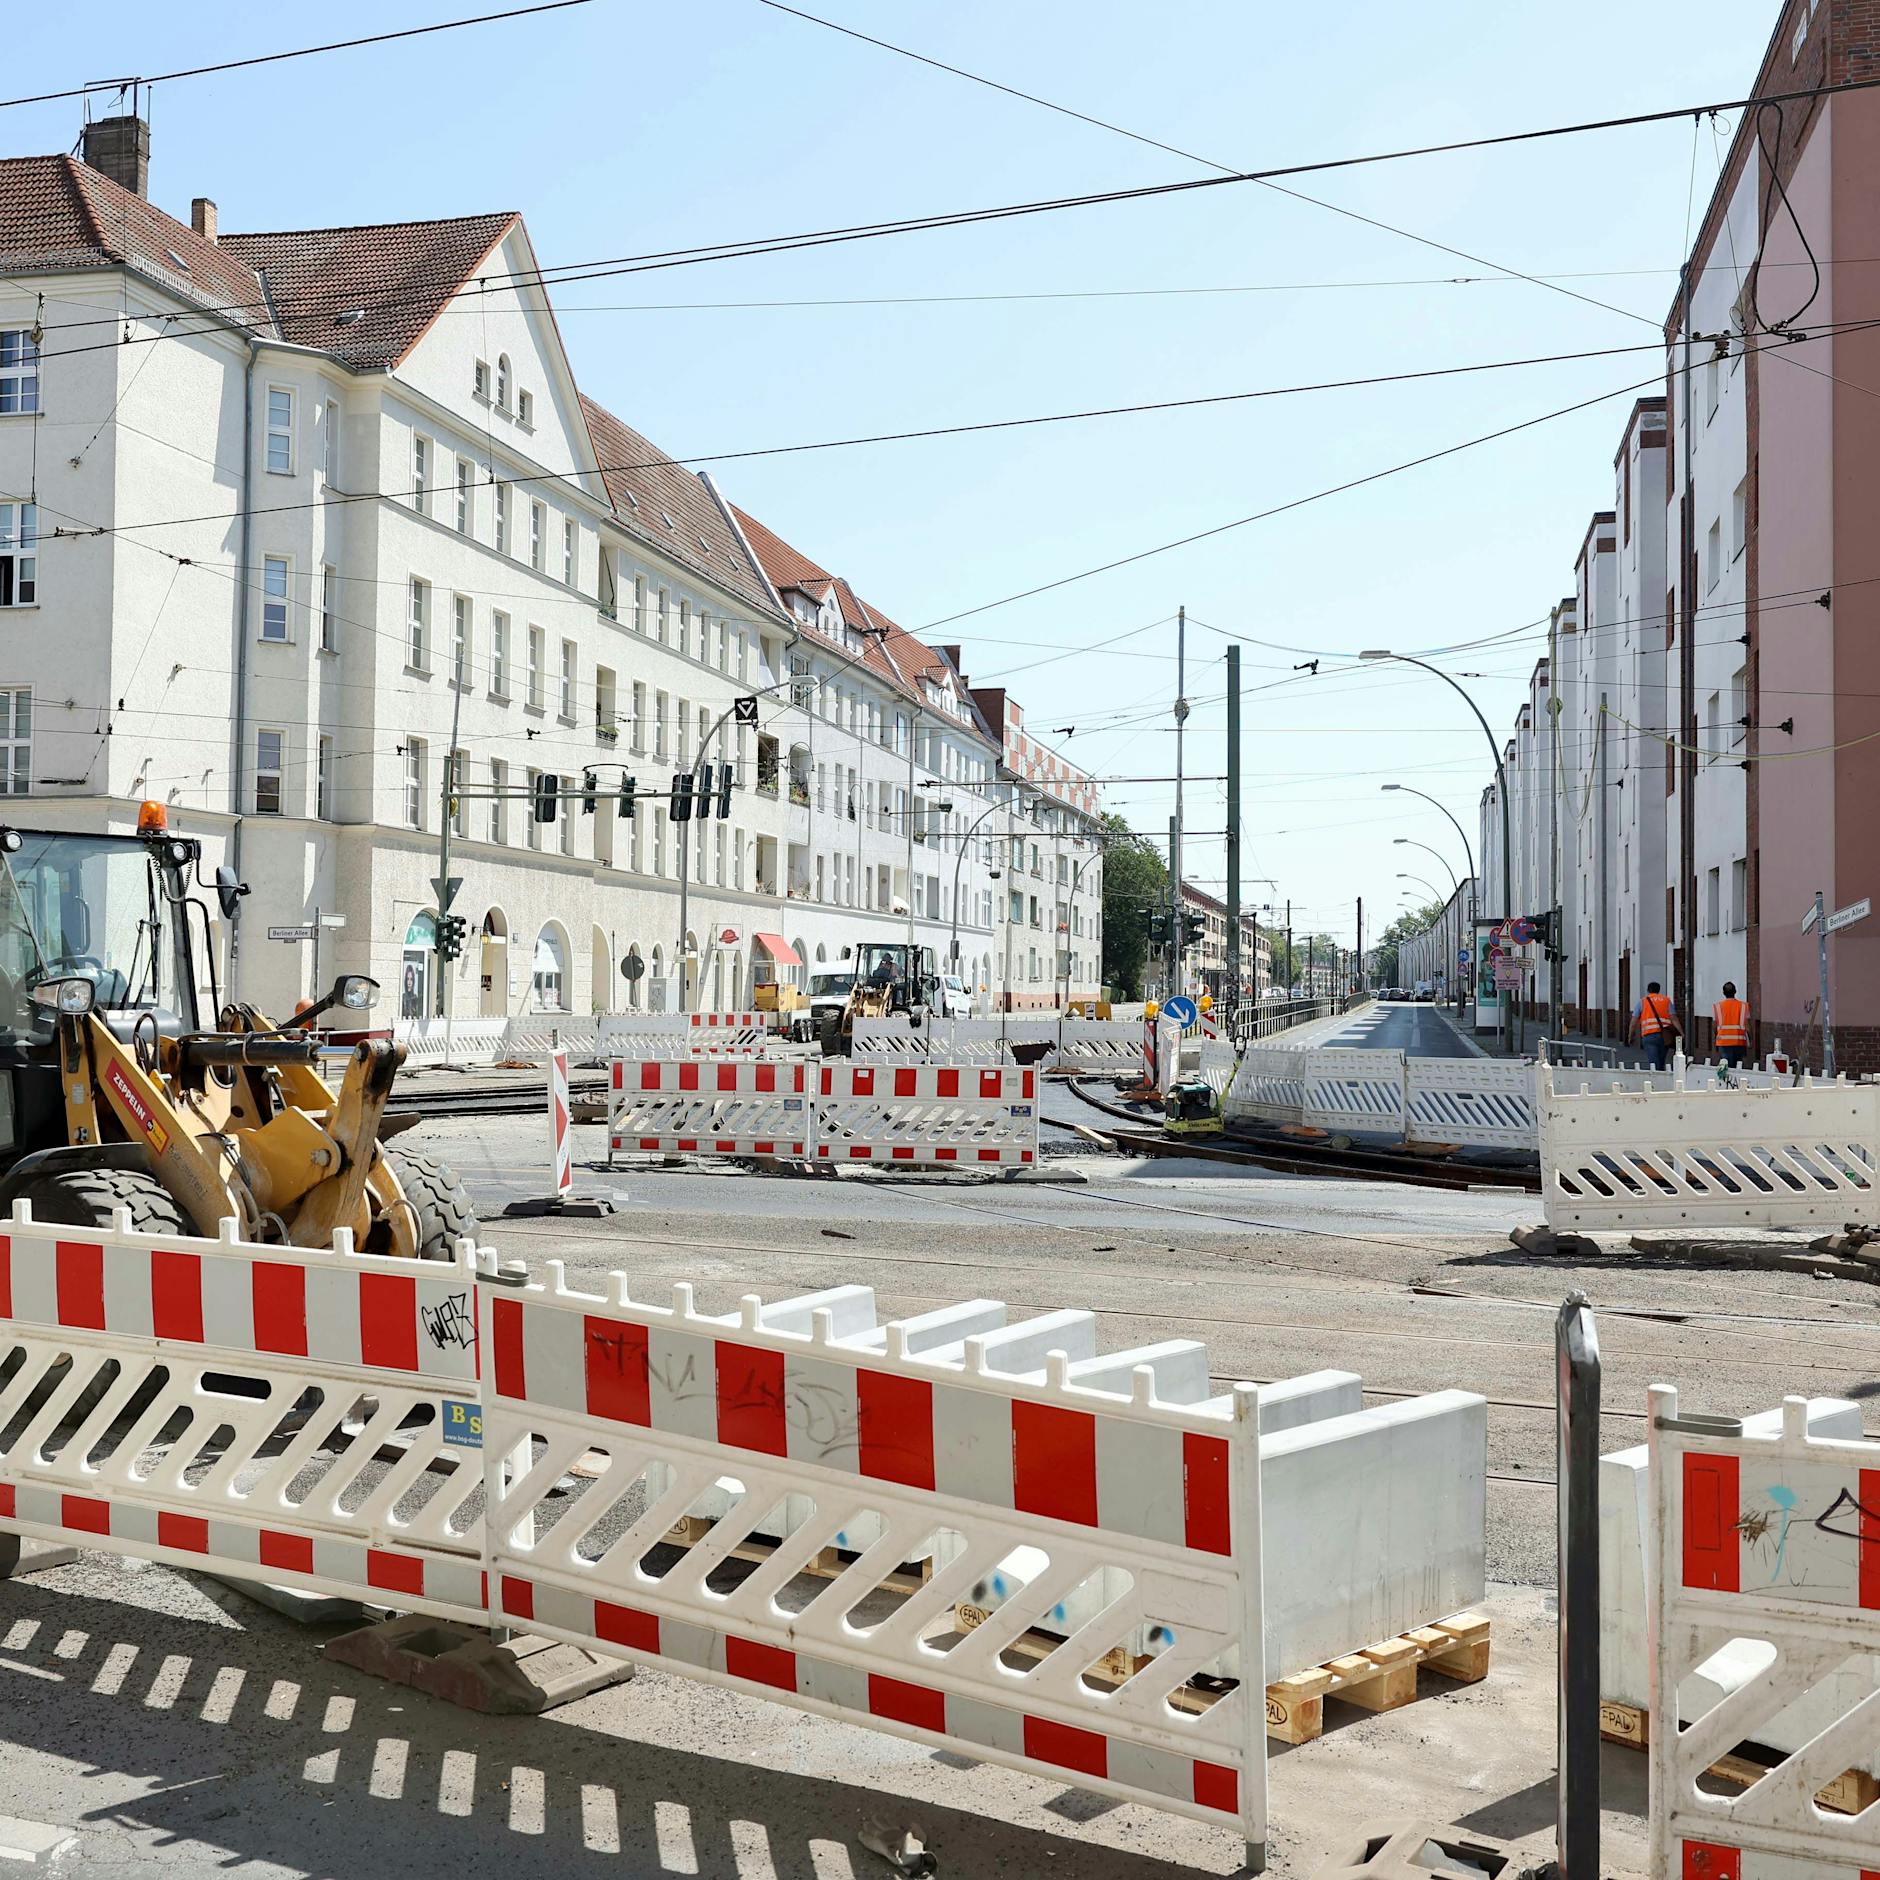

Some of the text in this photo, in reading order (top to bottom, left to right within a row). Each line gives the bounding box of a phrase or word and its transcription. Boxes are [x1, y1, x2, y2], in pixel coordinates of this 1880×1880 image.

[1829, 906, 1866, 927] Berliner Allee
[113, 1072, 146, 1120] ZEPPELIN
[963, 1608, 982, 1625] EPAL
[1265, 1701, 1282, 1721] PAL
